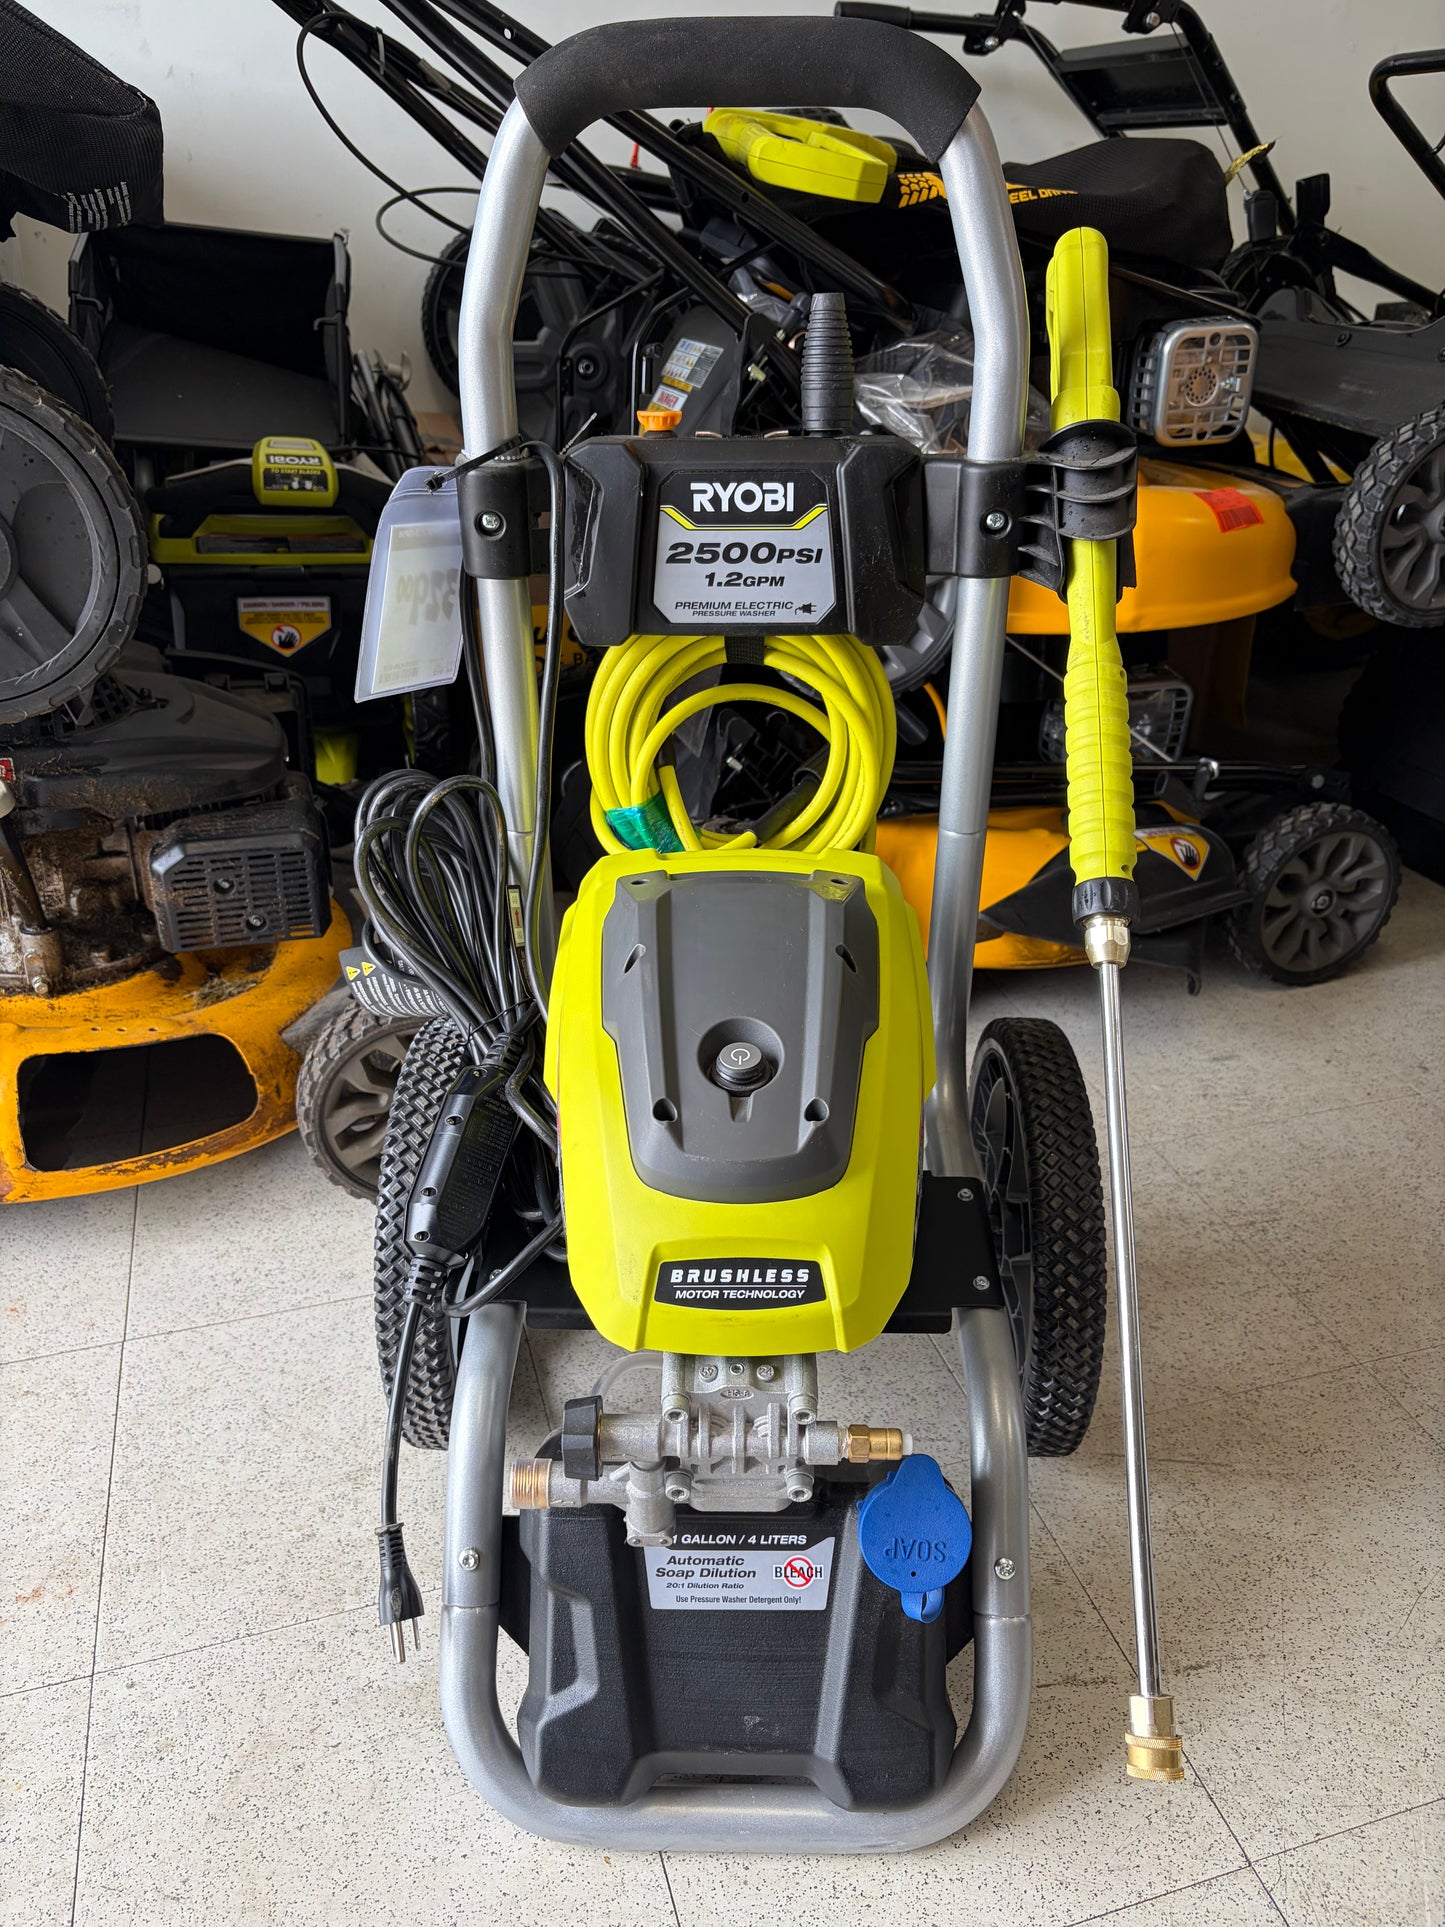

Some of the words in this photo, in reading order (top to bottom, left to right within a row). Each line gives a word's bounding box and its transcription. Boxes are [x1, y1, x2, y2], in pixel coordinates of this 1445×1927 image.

[1009, 190, 1038, 204] EEL
[269, 455, 321, 465] RYOBI
[690, 482, 795, 513] RYOBI
[665, 541, 823, 565] 2500PSI
[704, 571, 785, 587] 1.2GPM
[675, 601, 731, 610] PREMIUM
[734, 601, 793, 610] ELECTRIC
[670, 1269, 809, 1283] BRUSHLESS
[675, 1289, 719, 1299] MOTOR
[722, 1289, 805, 1299] TECHNOLOGY
[672, 1534, 677, 1545] 1
[681, 1534, 736, 1545] GALLON
[739, 1534, 745, 1544] /
[748, 1534, 756, 1544] 4
[760, 1534, 807, 1545] LITERS
[883, 1537, 946, 1563] SOAP
[666, 1555, 745, 1566] Automatic
[655, 1567, 695, 1580] Soap
[699, 1567, 757, 1578] Dilution
[774, 1566, 823, 1578] BLEACH
[676, 1595, 689, 1603] Use
[690, 1595, 720, 1603] Pressure
[722, 1595, 747, 1603] Washer
[749, 1595, 782, 1605] Detergent
[784, 1595, 802, 1605] Only!
